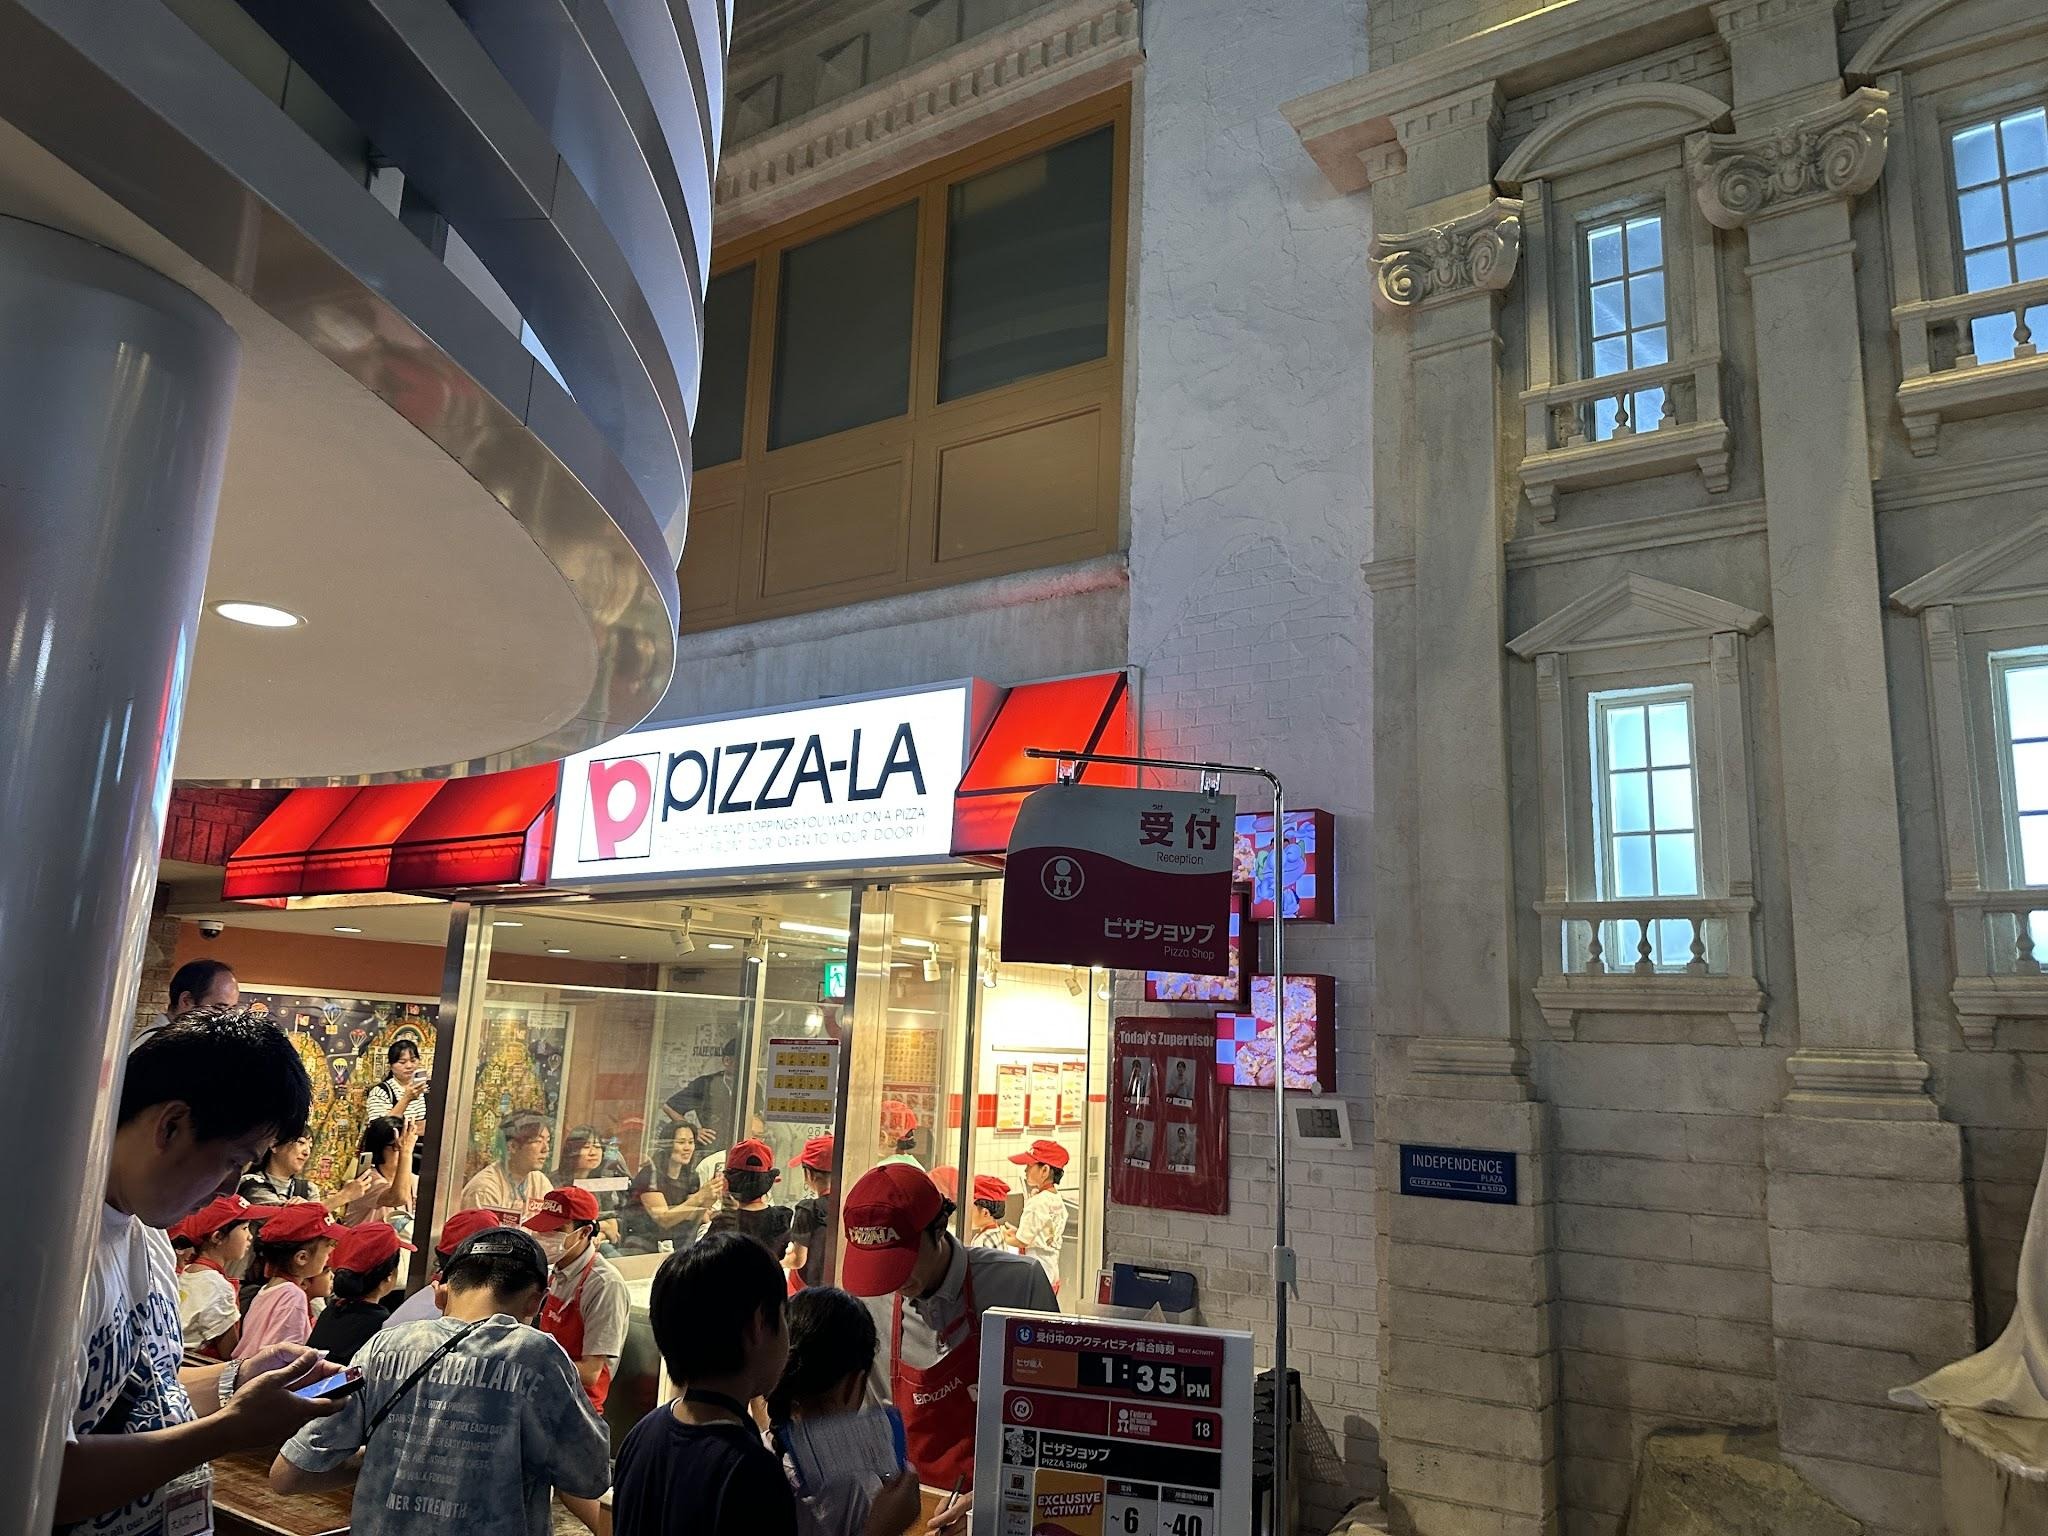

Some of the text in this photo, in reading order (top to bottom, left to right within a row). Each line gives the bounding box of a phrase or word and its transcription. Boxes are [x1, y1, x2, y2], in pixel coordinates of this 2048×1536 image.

[661, 722, 927, 822] PIZZA-LA
[862, 811, 882, 824] ON
[895, 807, 926, 821] PIZZA
[1139, 811, 1221, 851] 受付
[1156, 851, 1204, 866] Reception
[1104, 917, 1216, 944] ピザショップ
[1164, 945, 1215, 962] Pizza Shop
[1119, 1030, 1215, 1048] Today's Zupervisor
[1412, 1153, 1503, 1174] INDEPENDENCE
[1480, 1174, 1504, 1184] PLAZA
[371, 1349, 545, 1400] COUNERBALANCE
[1101, 1356, 1211, 1399] 1:35 PM
[1195, 1422, 1211, 1438] 18
[1042, 1441, 1111, 1462] ピザショップ
[1041, 1457, 1088, 1471] PIZZA SHOP
[1037, 1492, 1102, 1507] EXCLUSIVE
[1043, 1503, 1093, 1517] ACTIVITY
